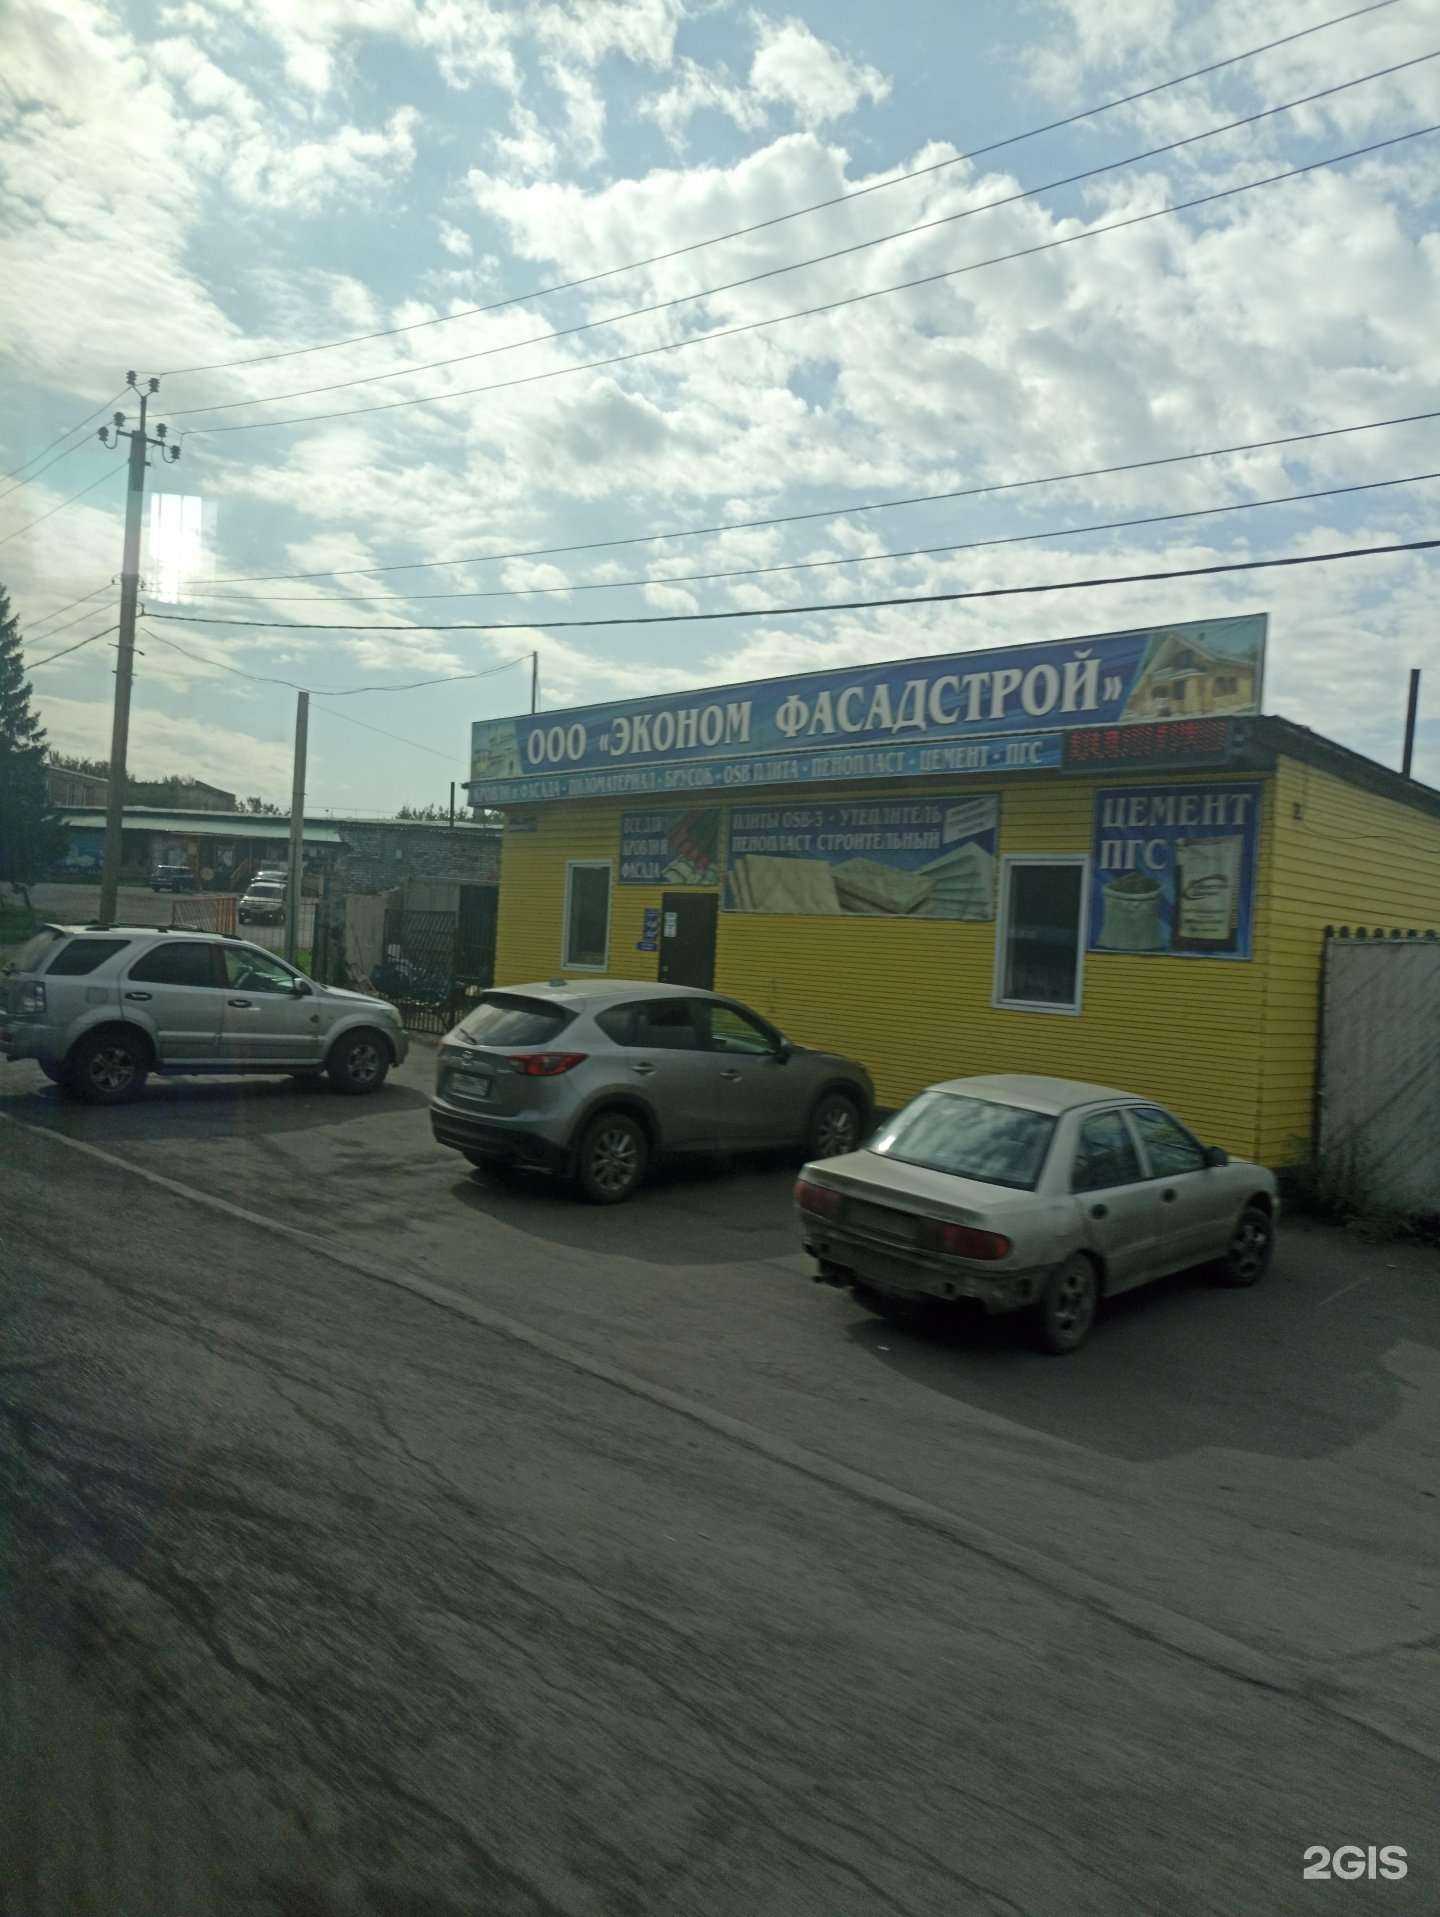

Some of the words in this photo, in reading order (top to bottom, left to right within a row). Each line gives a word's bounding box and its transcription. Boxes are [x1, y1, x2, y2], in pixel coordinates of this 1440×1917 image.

[527, 722, 587, 765] ООО
[600, 700, 753, 756] «ЭКОНОМ
[775, 648, 1123, 738] ФАСАДСТРОЙ»
[723, 764, 751, 784] OSB
[919, 745, 990, 772] ЦЕМЕНТ
[1005, 741, 1043, 765] ПГС
[839, 806, 943, 826] УТЕПЛИТЕЛЬ
[1102, 793, 1252, 829] ЦЕМЕНТ
[1100, 838, 1168, 870] ПГС
